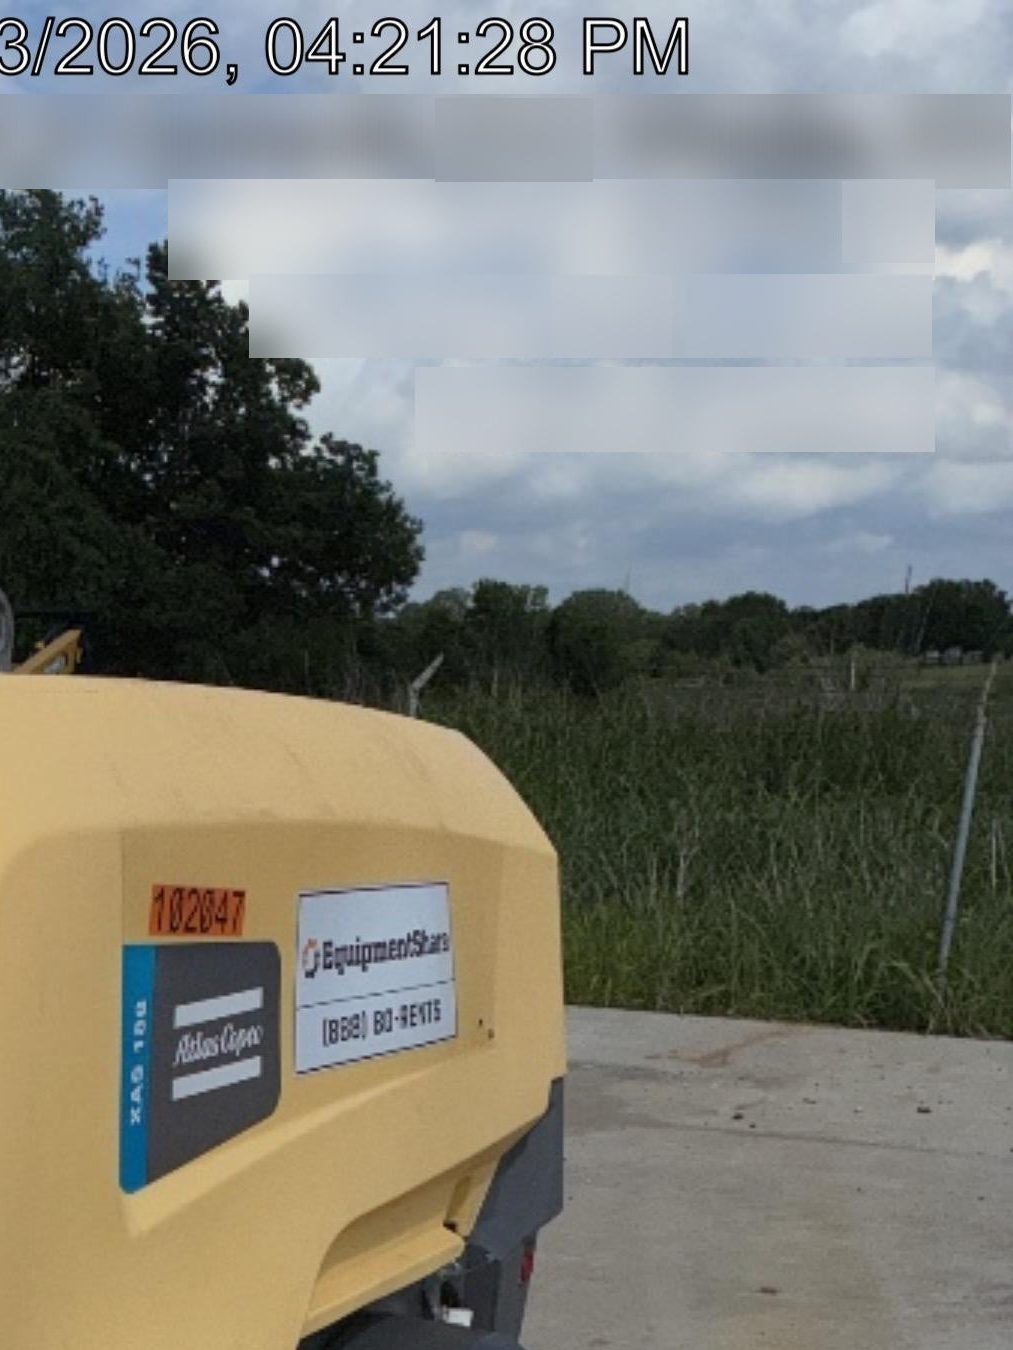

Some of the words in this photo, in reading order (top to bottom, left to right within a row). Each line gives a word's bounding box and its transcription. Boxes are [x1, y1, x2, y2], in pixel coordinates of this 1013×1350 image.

[154, 887, 245, 934] 102047
[322, 929, 449, 976] EquipmentShare
[172, 1031, 219, 1067] Atlas
[220, 1023, 263, 1057] Copco
[131, 1064, 144, 1125] XAS
